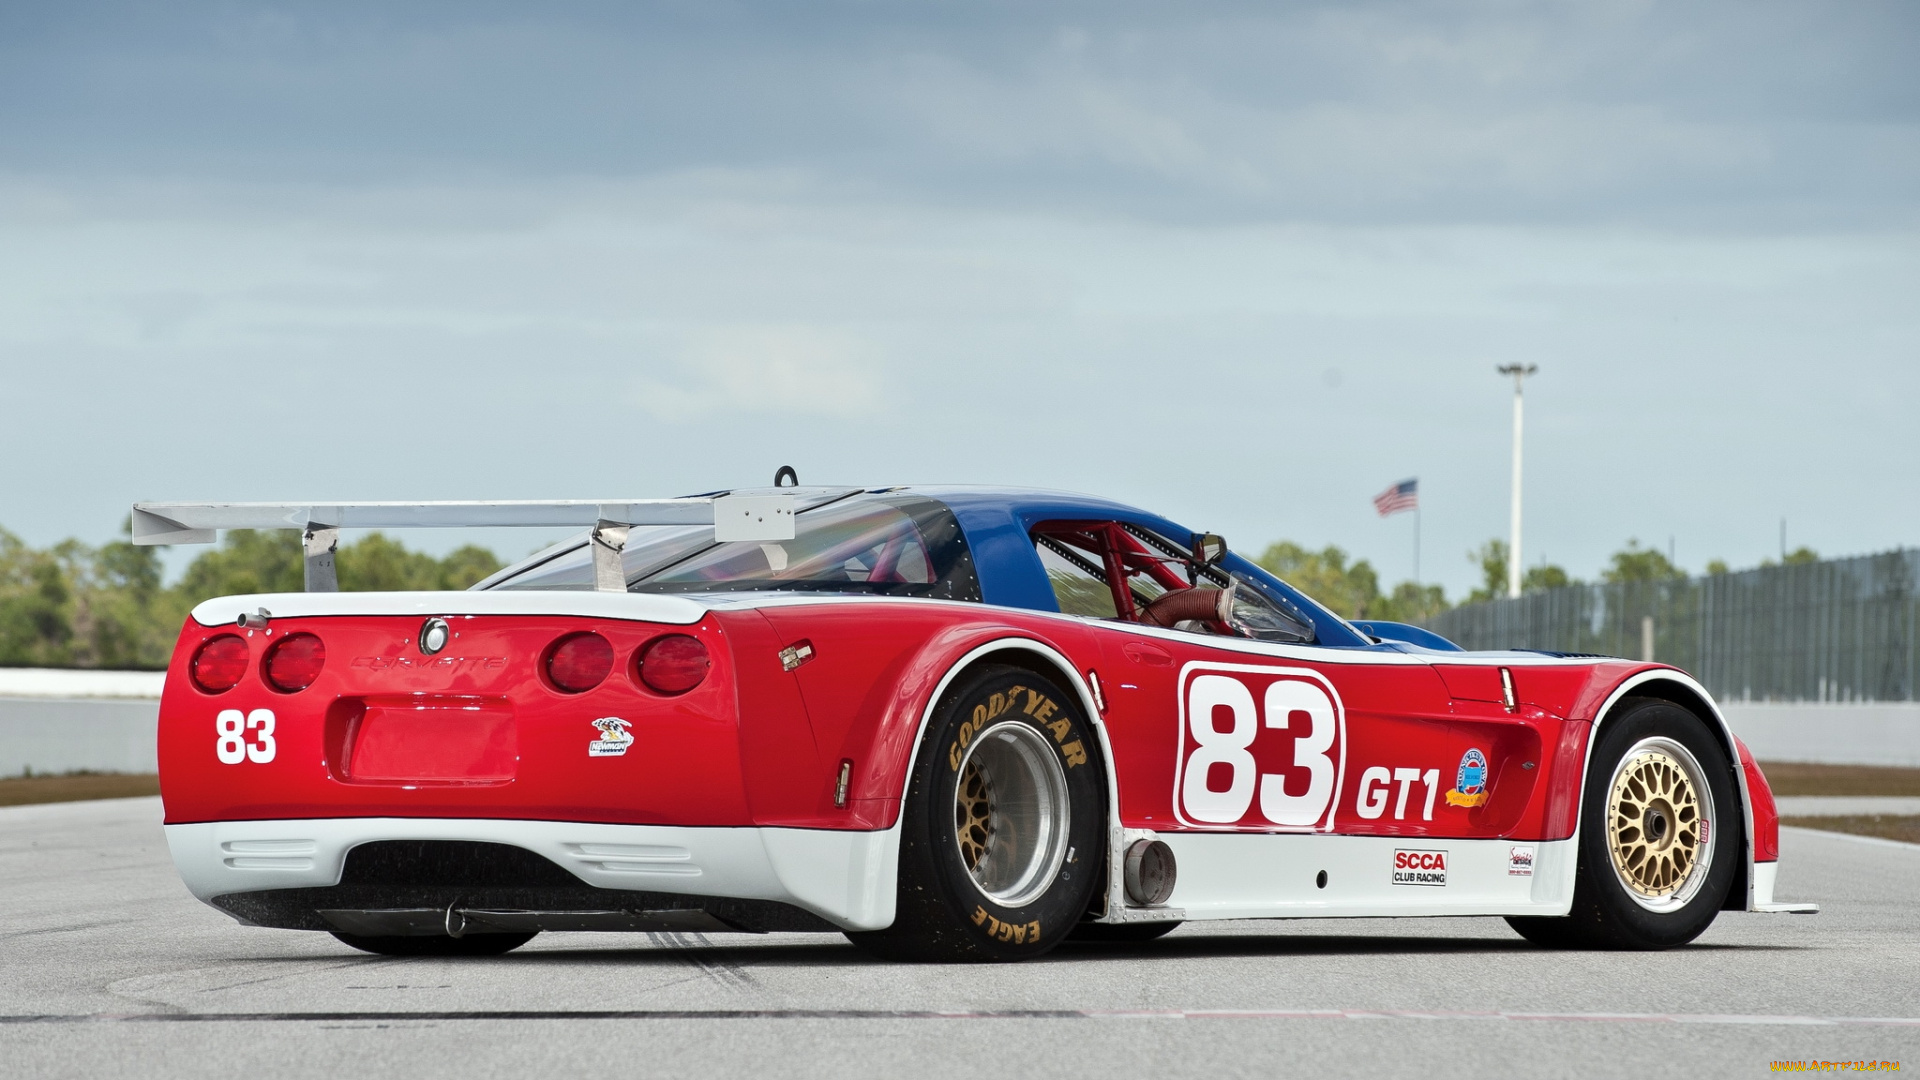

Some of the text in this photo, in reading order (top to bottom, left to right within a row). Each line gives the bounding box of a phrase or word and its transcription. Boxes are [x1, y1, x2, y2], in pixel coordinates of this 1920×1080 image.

[350, 656, 508, 674] CORVETTE
[216, 708, 277, 765] 83
[950, 685, 1087, 772] GOODYEAR
[1183, 675, 1336, 826] 83
[1356, 766, 1440, 821] GT1
[1394, 872, 1445, 883] CLUB RACING
[1395, 852, 1446, 870] SCCA
[971, 905, 1040, 944] EAGLE
